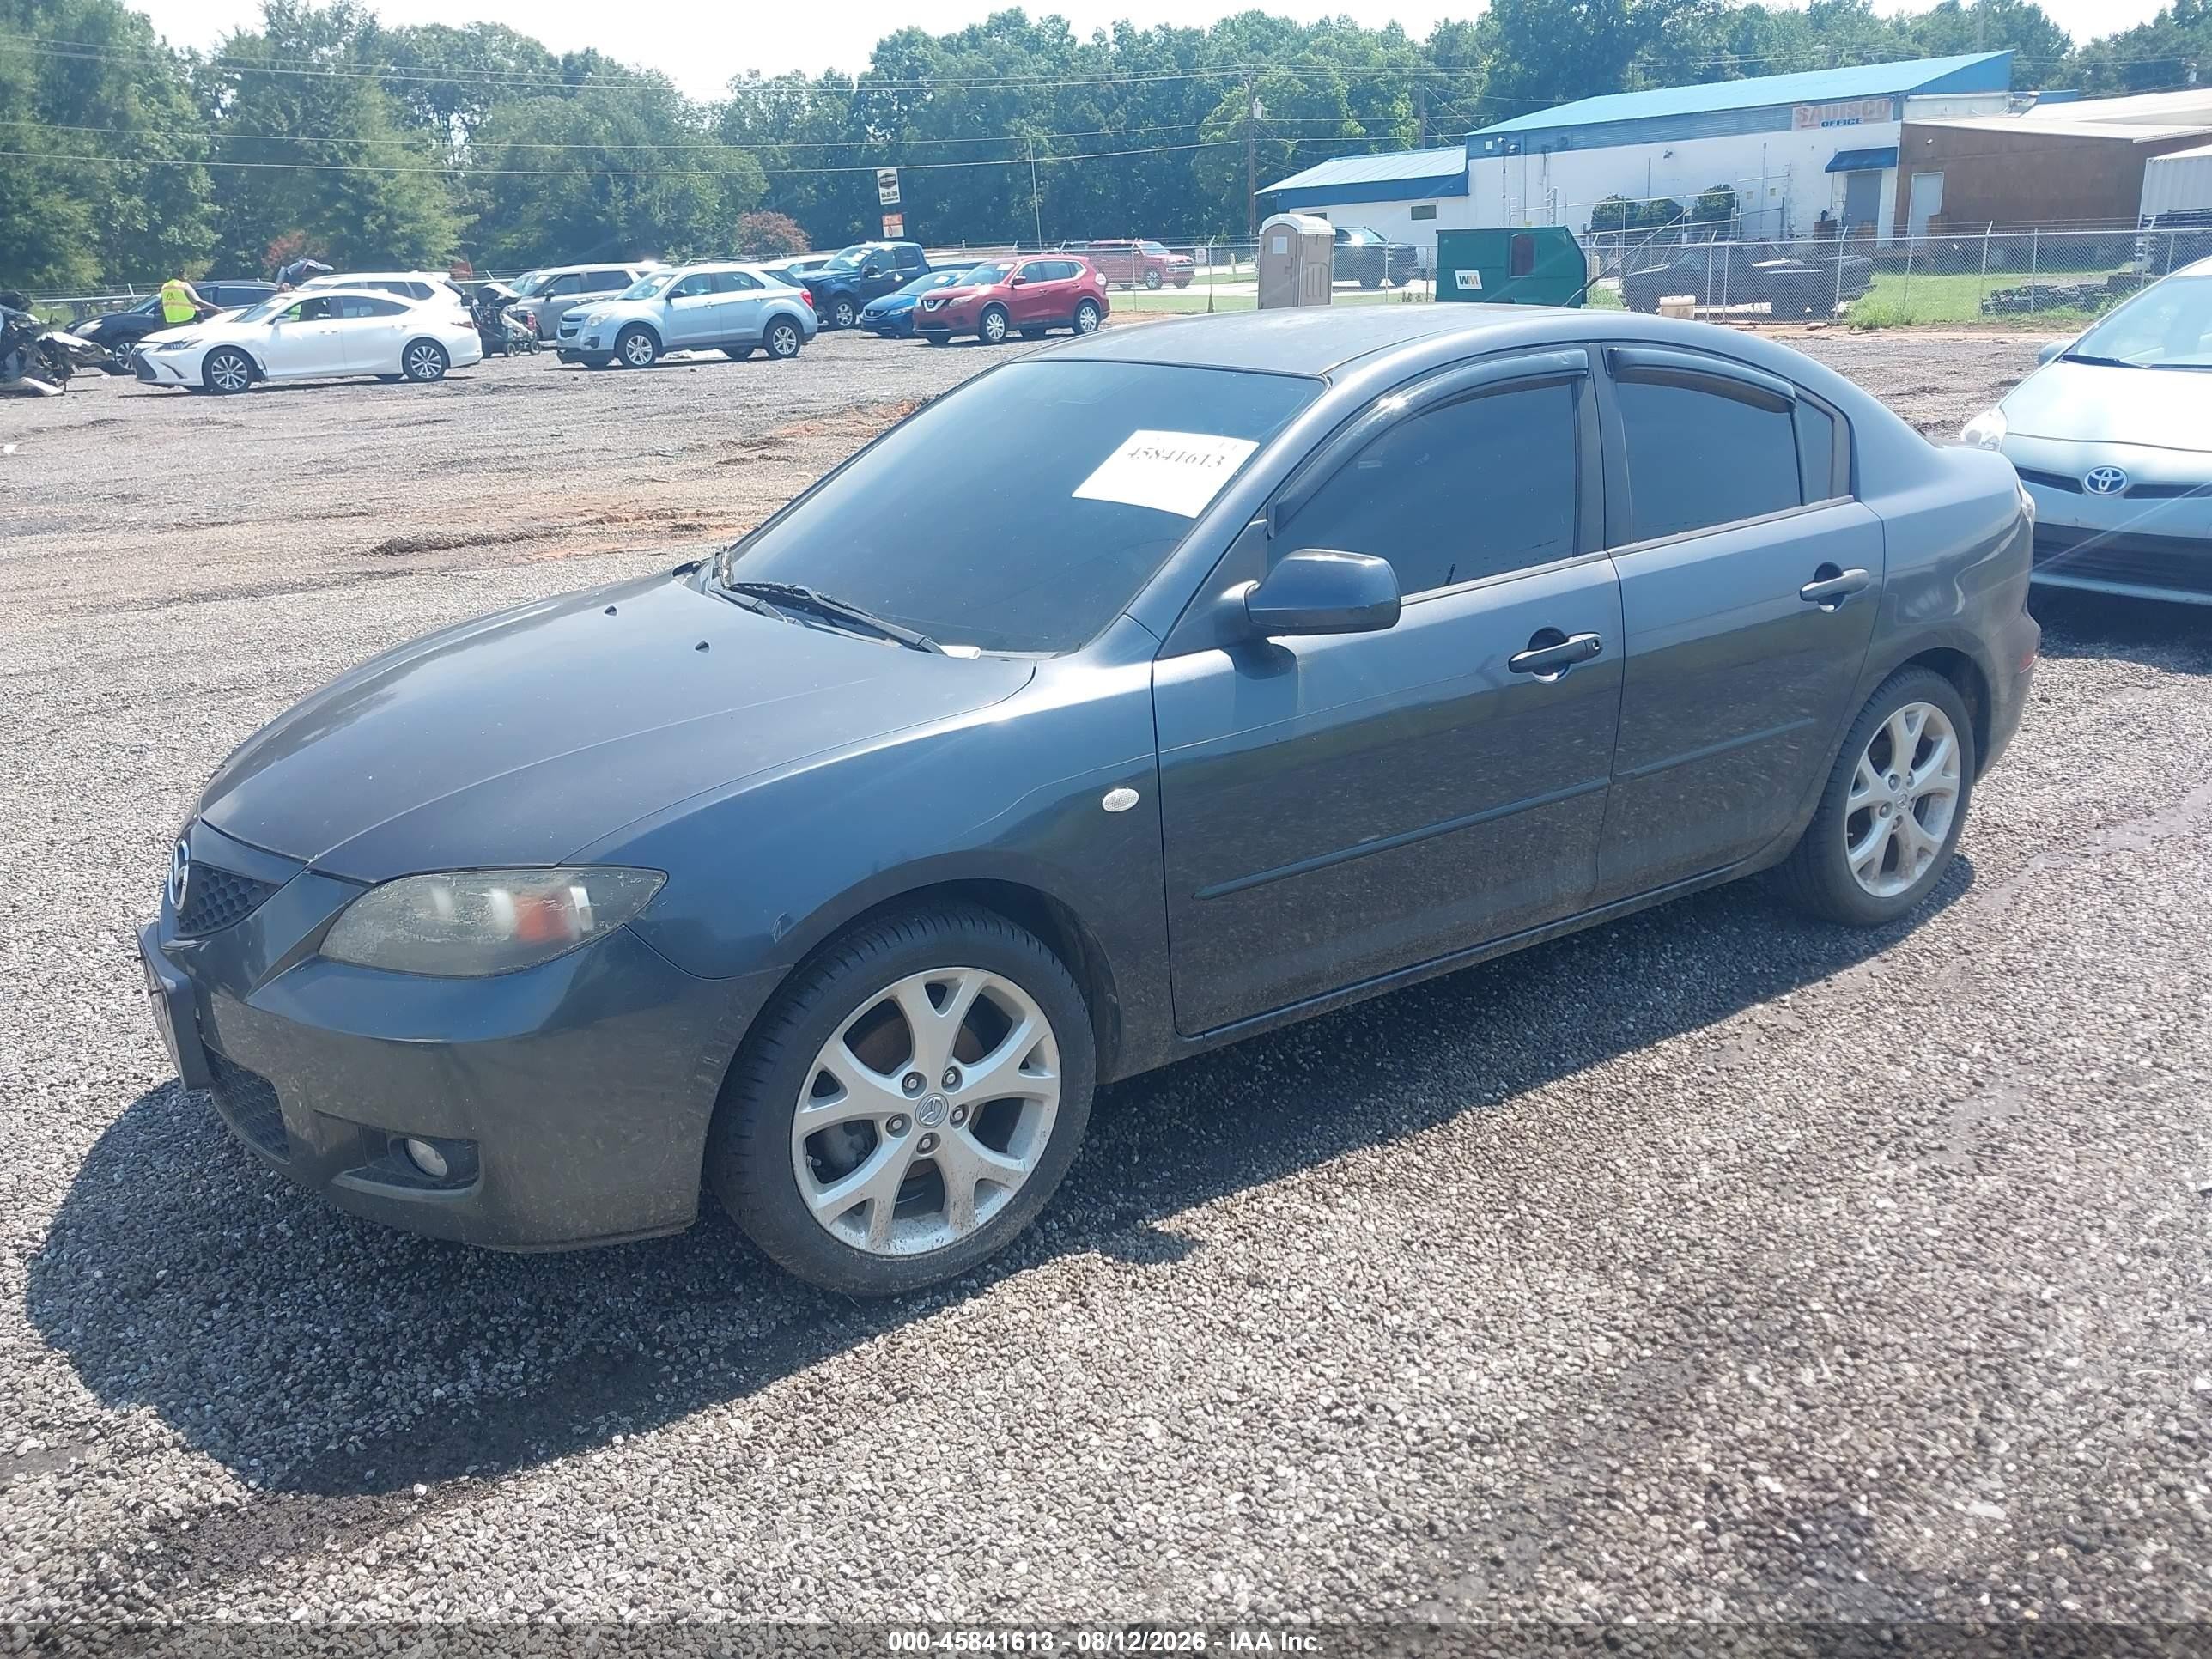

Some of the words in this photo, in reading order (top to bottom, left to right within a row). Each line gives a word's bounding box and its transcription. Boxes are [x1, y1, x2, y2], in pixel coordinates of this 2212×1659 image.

[1821, 118, 1863, 128] OFFICE
[1458, 275, 1479, 285] WM
[1127, 447, 1225, 468] 45841613
